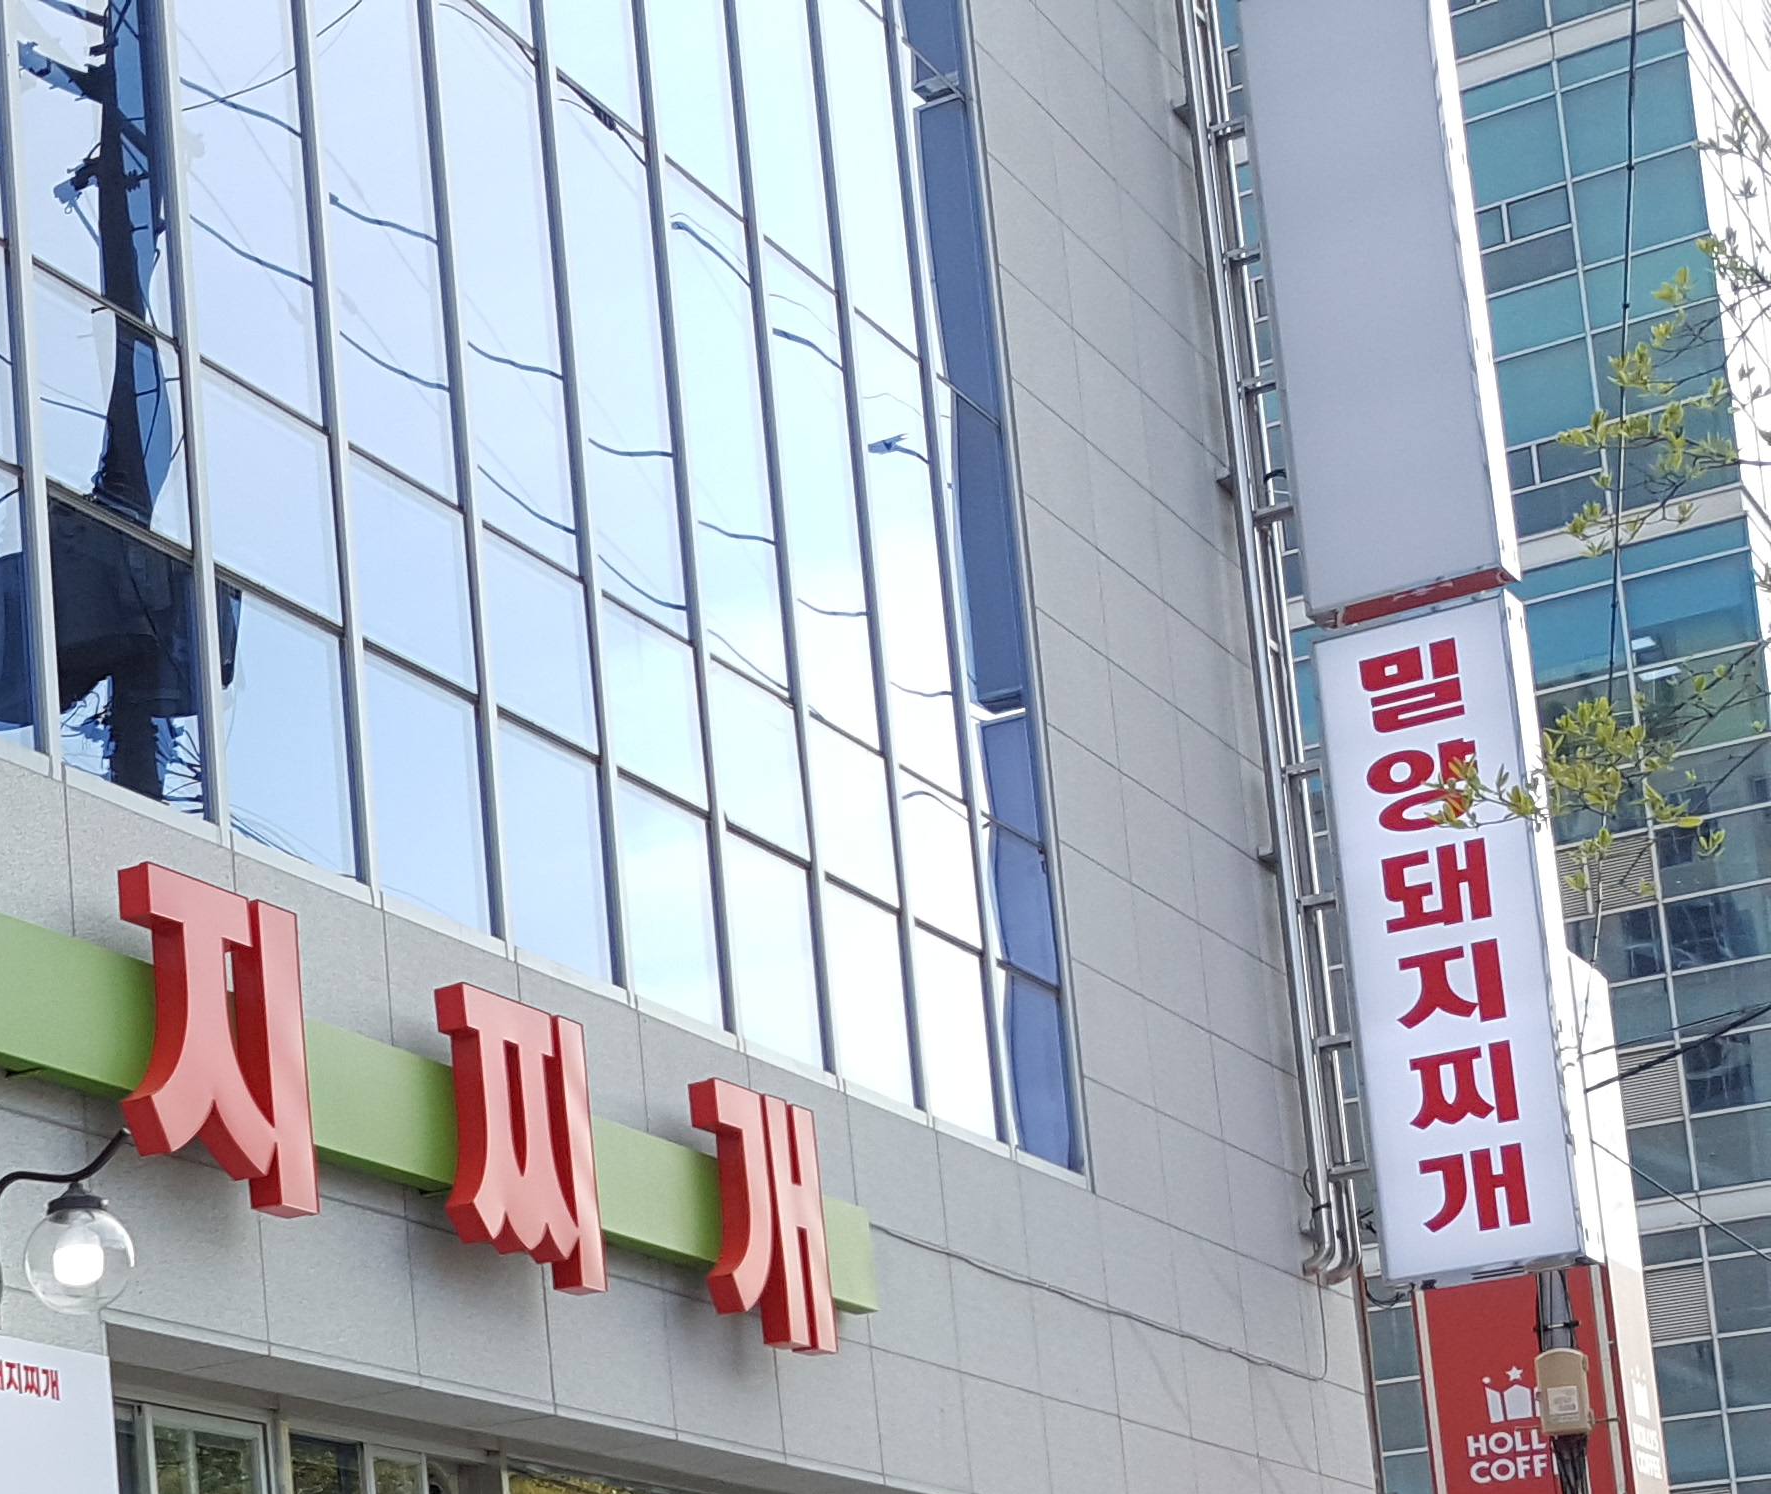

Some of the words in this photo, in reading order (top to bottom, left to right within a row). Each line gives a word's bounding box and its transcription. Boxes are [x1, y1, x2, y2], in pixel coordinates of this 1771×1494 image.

[1359, 637, 1531, 1233] 밀양돼지찌개
[1467, 1429, 1547, 1457] HOLL
[1470, 1453, 1559, 1484] COFF
